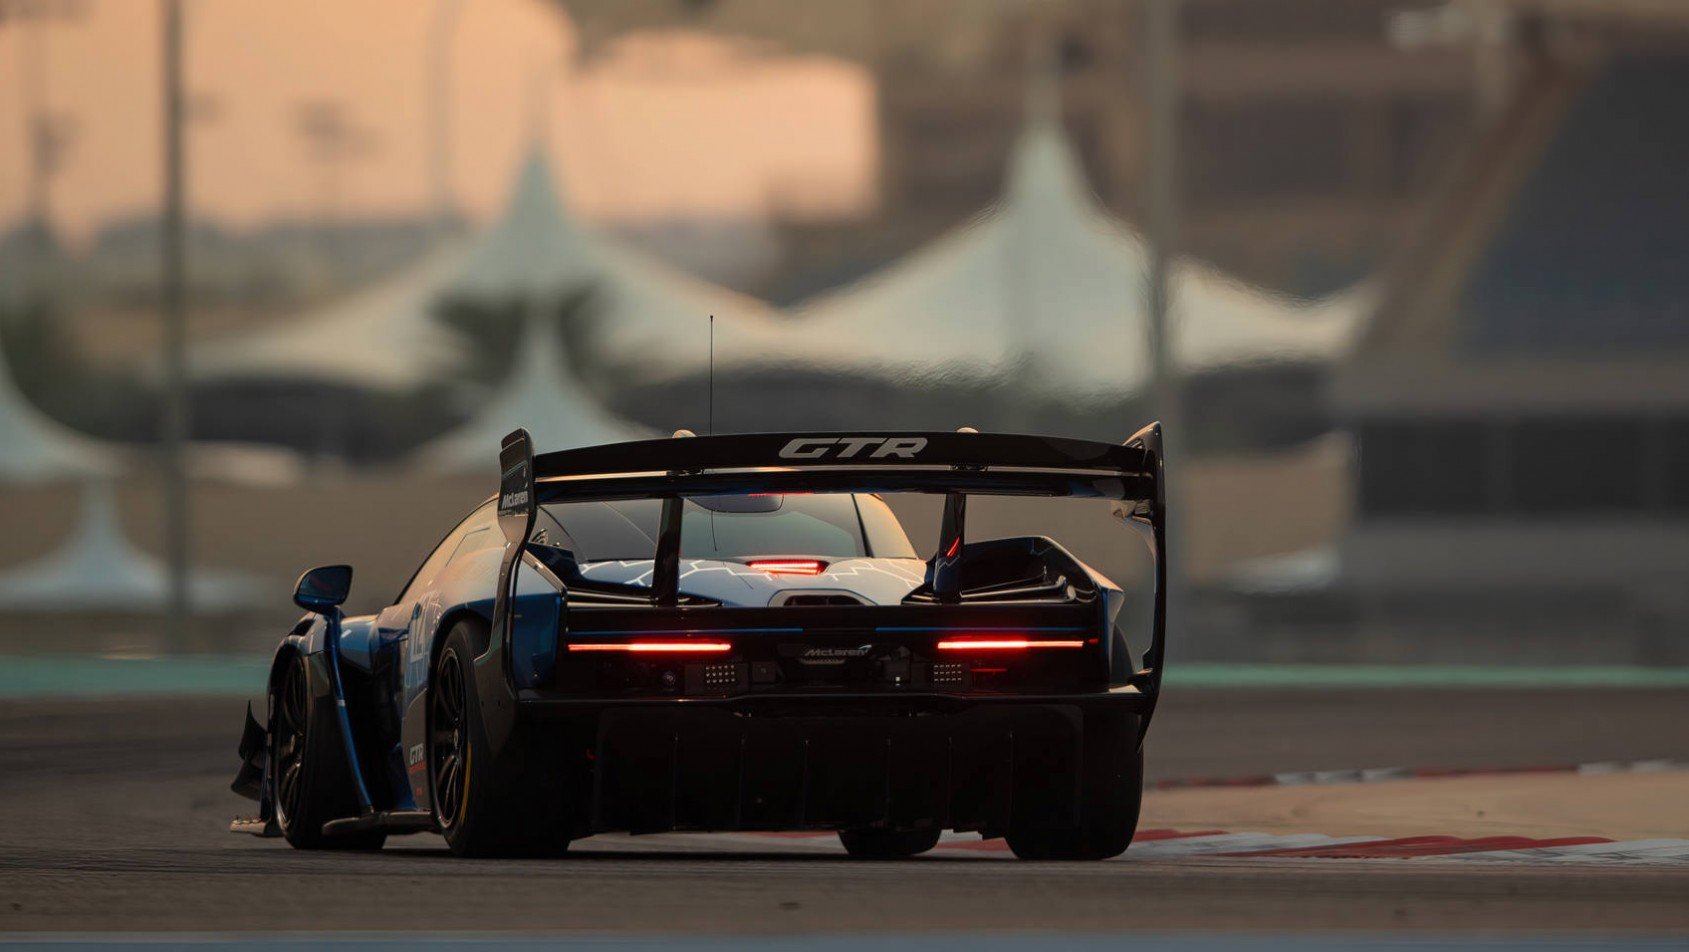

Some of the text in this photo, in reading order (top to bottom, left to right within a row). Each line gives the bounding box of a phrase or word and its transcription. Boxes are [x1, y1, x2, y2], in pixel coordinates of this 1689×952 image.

[778, 437, 928, 458] GTR
[502, 490, 529, 510] McLaren
[804, 648, 866, 657] McLaren
[409, 743, 424, 766] GTR
